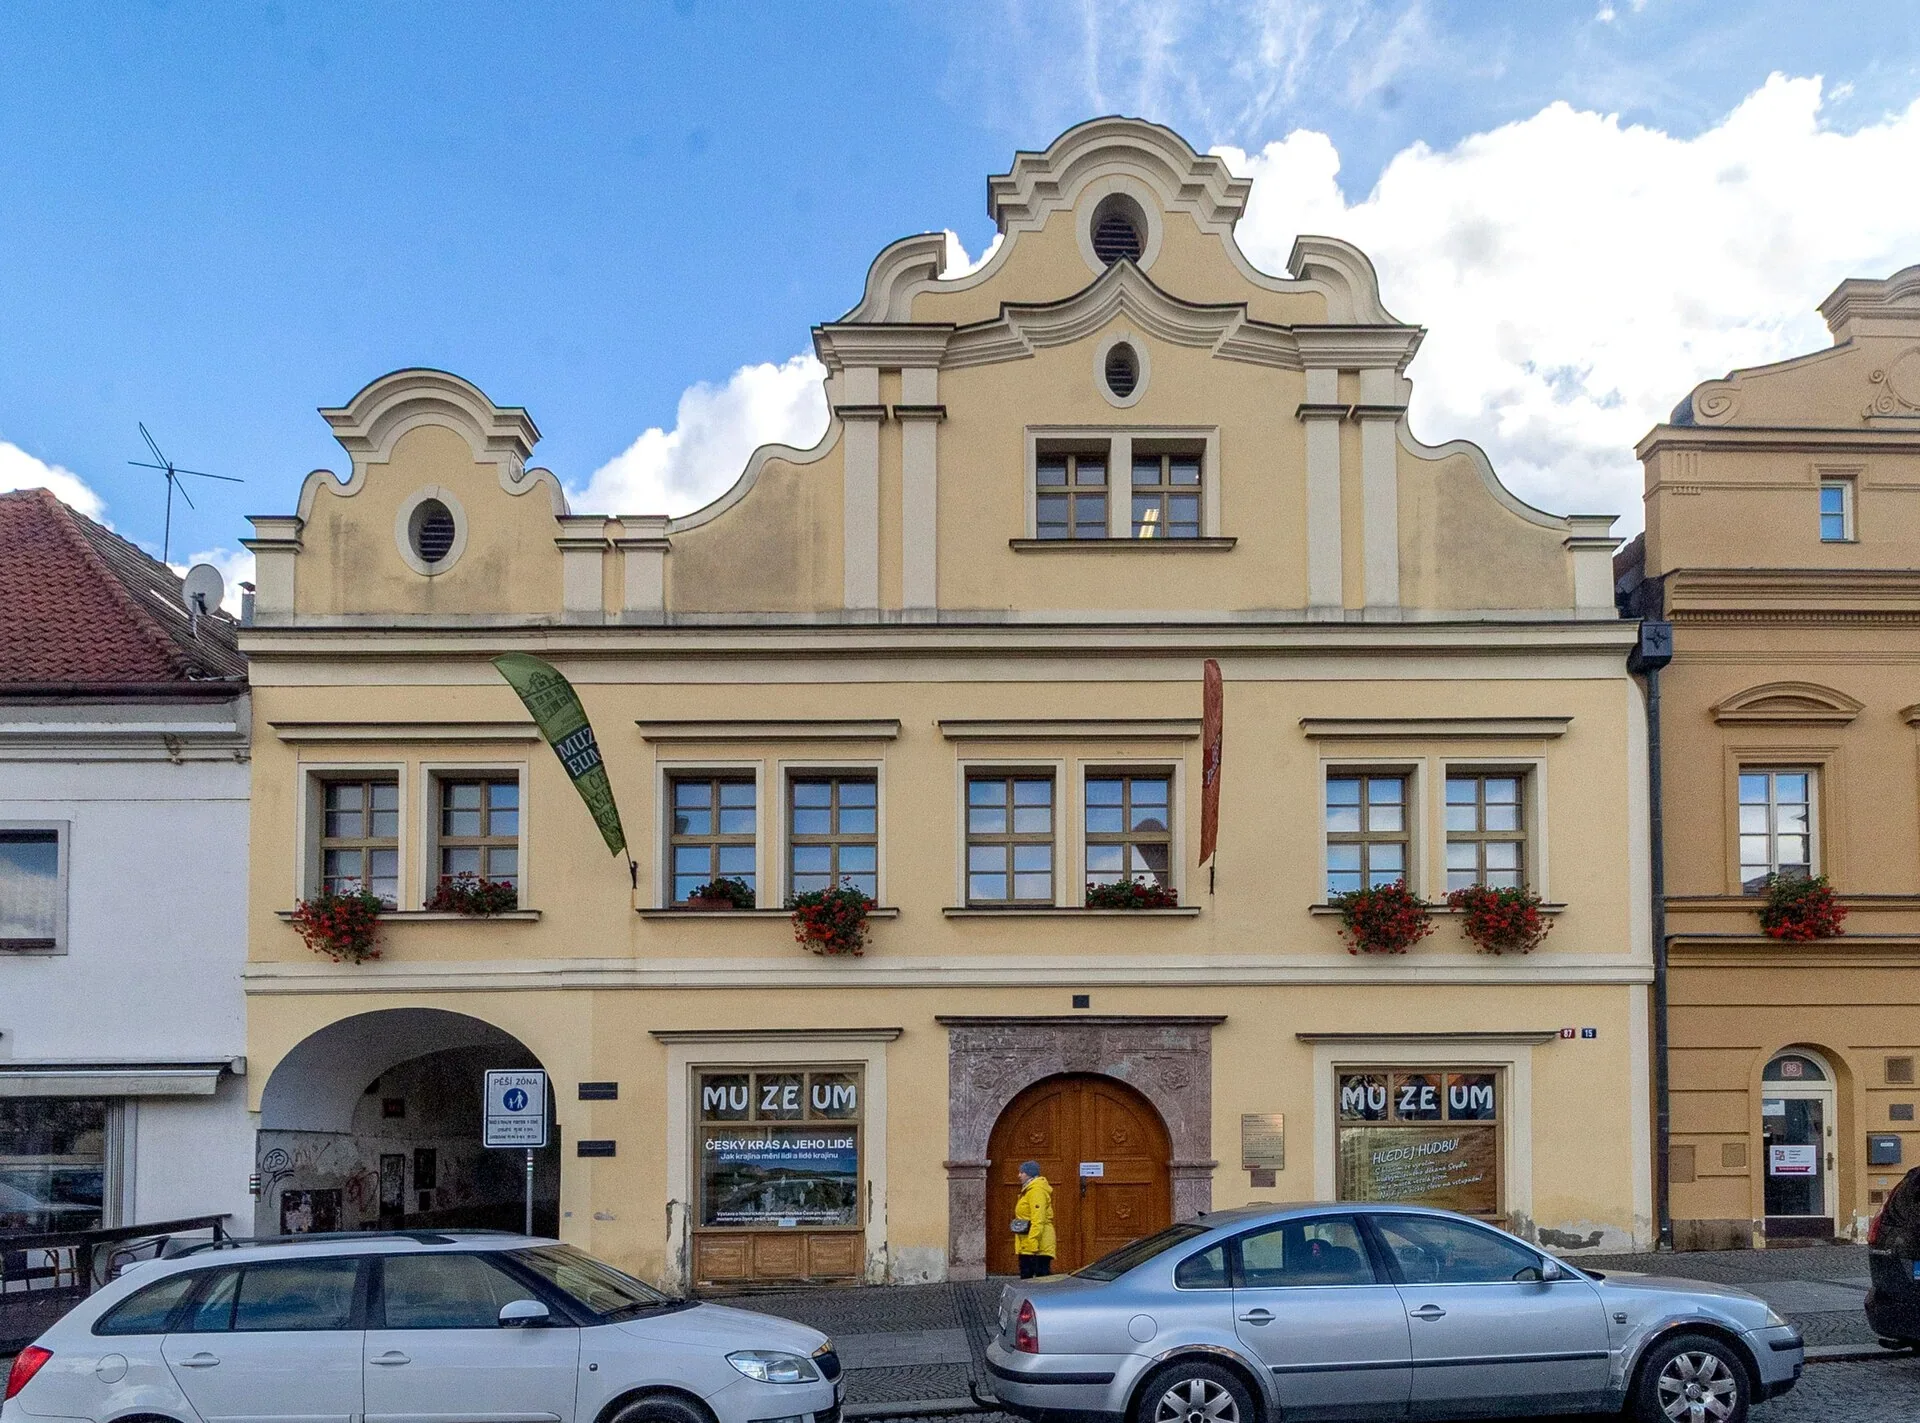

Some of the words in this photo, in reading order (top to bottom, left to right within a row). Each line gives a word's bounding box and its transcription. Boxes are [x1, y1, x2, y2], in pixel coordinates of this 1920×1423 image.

[1563, 1029, 1573, 1038] 87
[1584, 1029, 1593, 1038] 15
[493, 1077, 512, 1086] PĚŠÍ
[516, 1077, 538, 1086] ZÓNA
[705, 1138, 746, 1150] ČESKÝ
[748, 1140, 780, 1150] KRAS
[781, 1139, 791, 1149] A
[792, 1139, 825, 1149] JEHO
[827, 1137, 854, 1149] LIDÉ
[720, 1152, 735, 1160] Jak
[736, 1152, 760, 1161] krajina
[762, 1152, 780, 1160] mění
[799, 1151, 812, 1159] lidé
[813, 1151, 838, 1160] krajinu
[1372, 1146, 1415, 1165] HLEDEJ
[1418, 1138, 1460, 1156] HUDBU!
